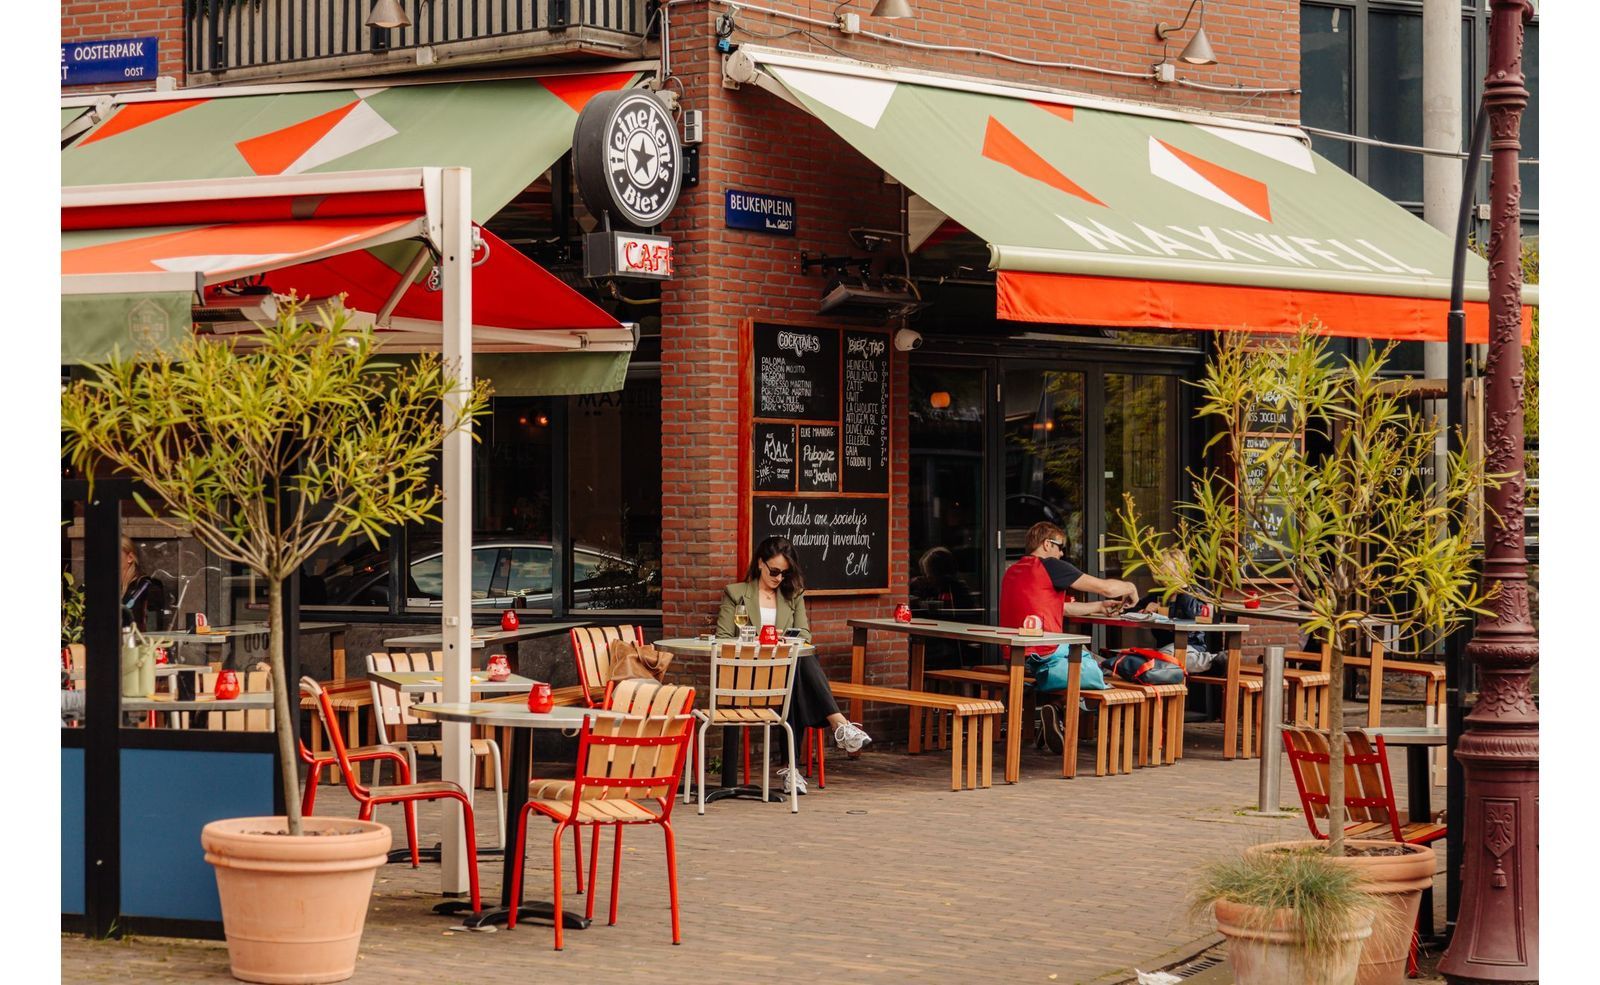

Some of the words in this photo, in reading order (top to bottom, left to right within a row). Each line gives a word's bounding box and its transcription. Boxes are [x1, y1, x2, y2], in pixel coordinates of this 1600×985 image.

[74, 42, 144, 61] OOSTERPARK
[124, 67, 144, 77] OOST
[608, 107, 673, 182] Heineken's
[622, 183, 660, 212] Bier
[730, 194, 792, 217] BEUKENPLEIN
[1054, 213, 1433, 275] MAXWELL
[777, 330, 821, 357] COCKTAILS
[761, 356, 786, 365] PALOMA
[761, 364, 785, 373] PASSION
[785, 365, 806, 374] MOJITO
[846, 359, 875, 371] HEINEKEN
[789, 380, 812, 389] MARTINI
[800, 427, 811, 438] ELKE
[864, 425, 875, 436] 666
[764, 438, 788, 461] AJAX
[803, 445, 835, 468] Pubquiz
[812, 468, 837, 489] Jocelyn
[814, 513, 828, 525] are
[792, 528, 829, 561] enduring
